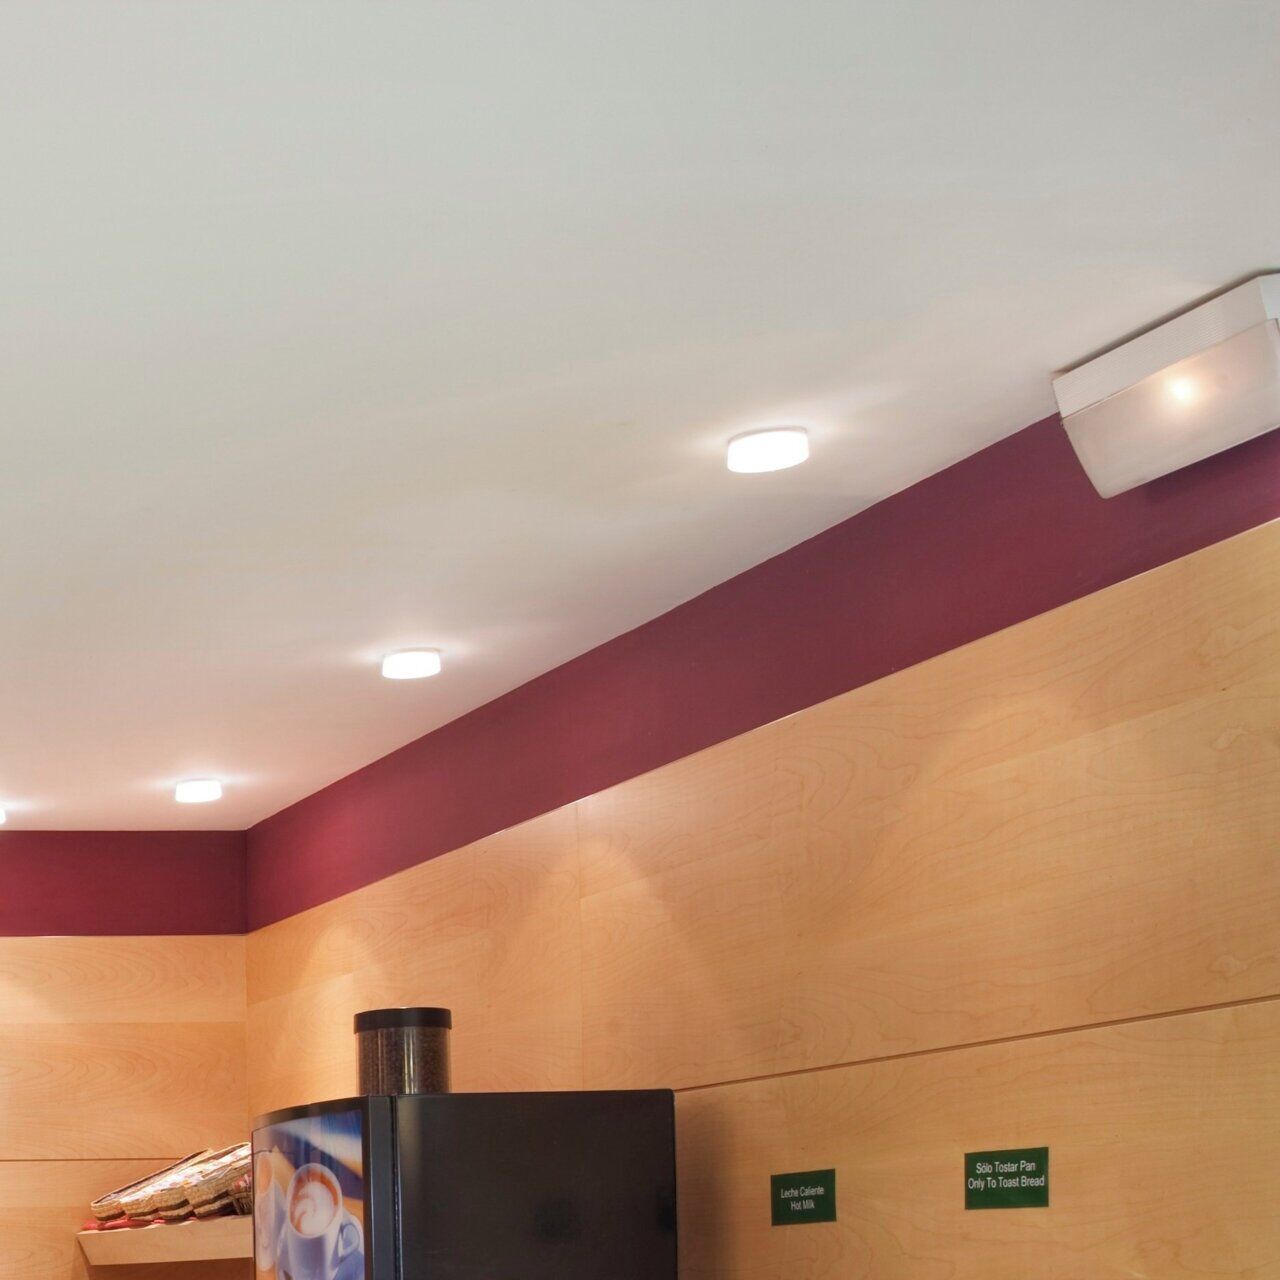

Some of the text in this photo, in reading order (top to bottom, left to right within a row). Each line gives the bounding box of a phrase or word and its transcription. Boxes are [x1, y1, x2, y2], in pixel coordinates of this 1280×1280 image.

[994, 1161, 1019, 1173] Tostar
[1020, 1160, 1036, 1172] Pan
[967, 1175, 1045, 1191] Only To Toast Bread
[780, 1188, 799, 1199] Leche
[790, 1200, 802, 1211] Hot
